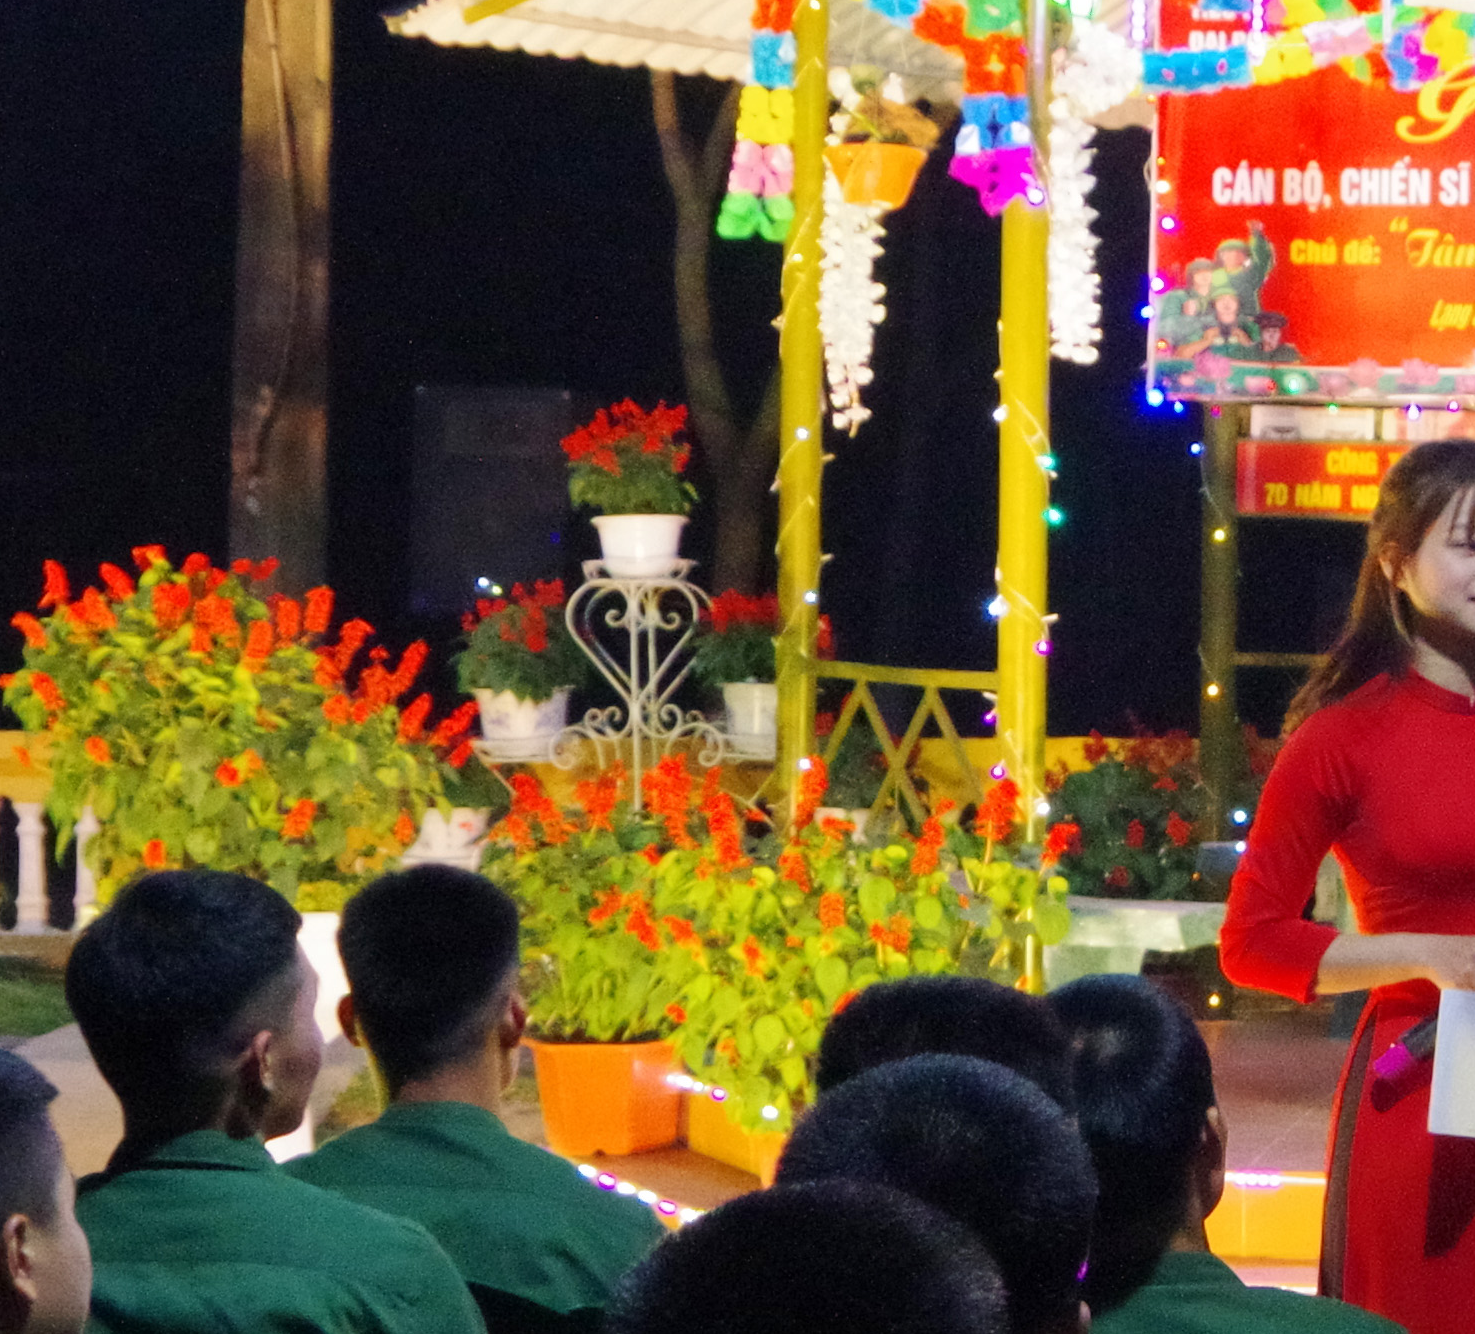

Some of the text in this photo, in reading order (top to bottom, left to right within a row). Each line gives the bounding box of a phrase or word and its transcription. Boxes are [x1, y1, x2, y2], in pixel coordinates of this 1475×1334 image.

[1212, 159, 1275, 206] CÁN
[1282, 160, 1332, 213] BỘ,
[1340, 155, 1431, 206] CHIẾN
[1438, 160, 1472, 206] SĨ
[1326, 447, 1378, 476] CÔNG
[1264, 482, 1289, 507] 70
[1294, 481, 1342, 509] NĂM
